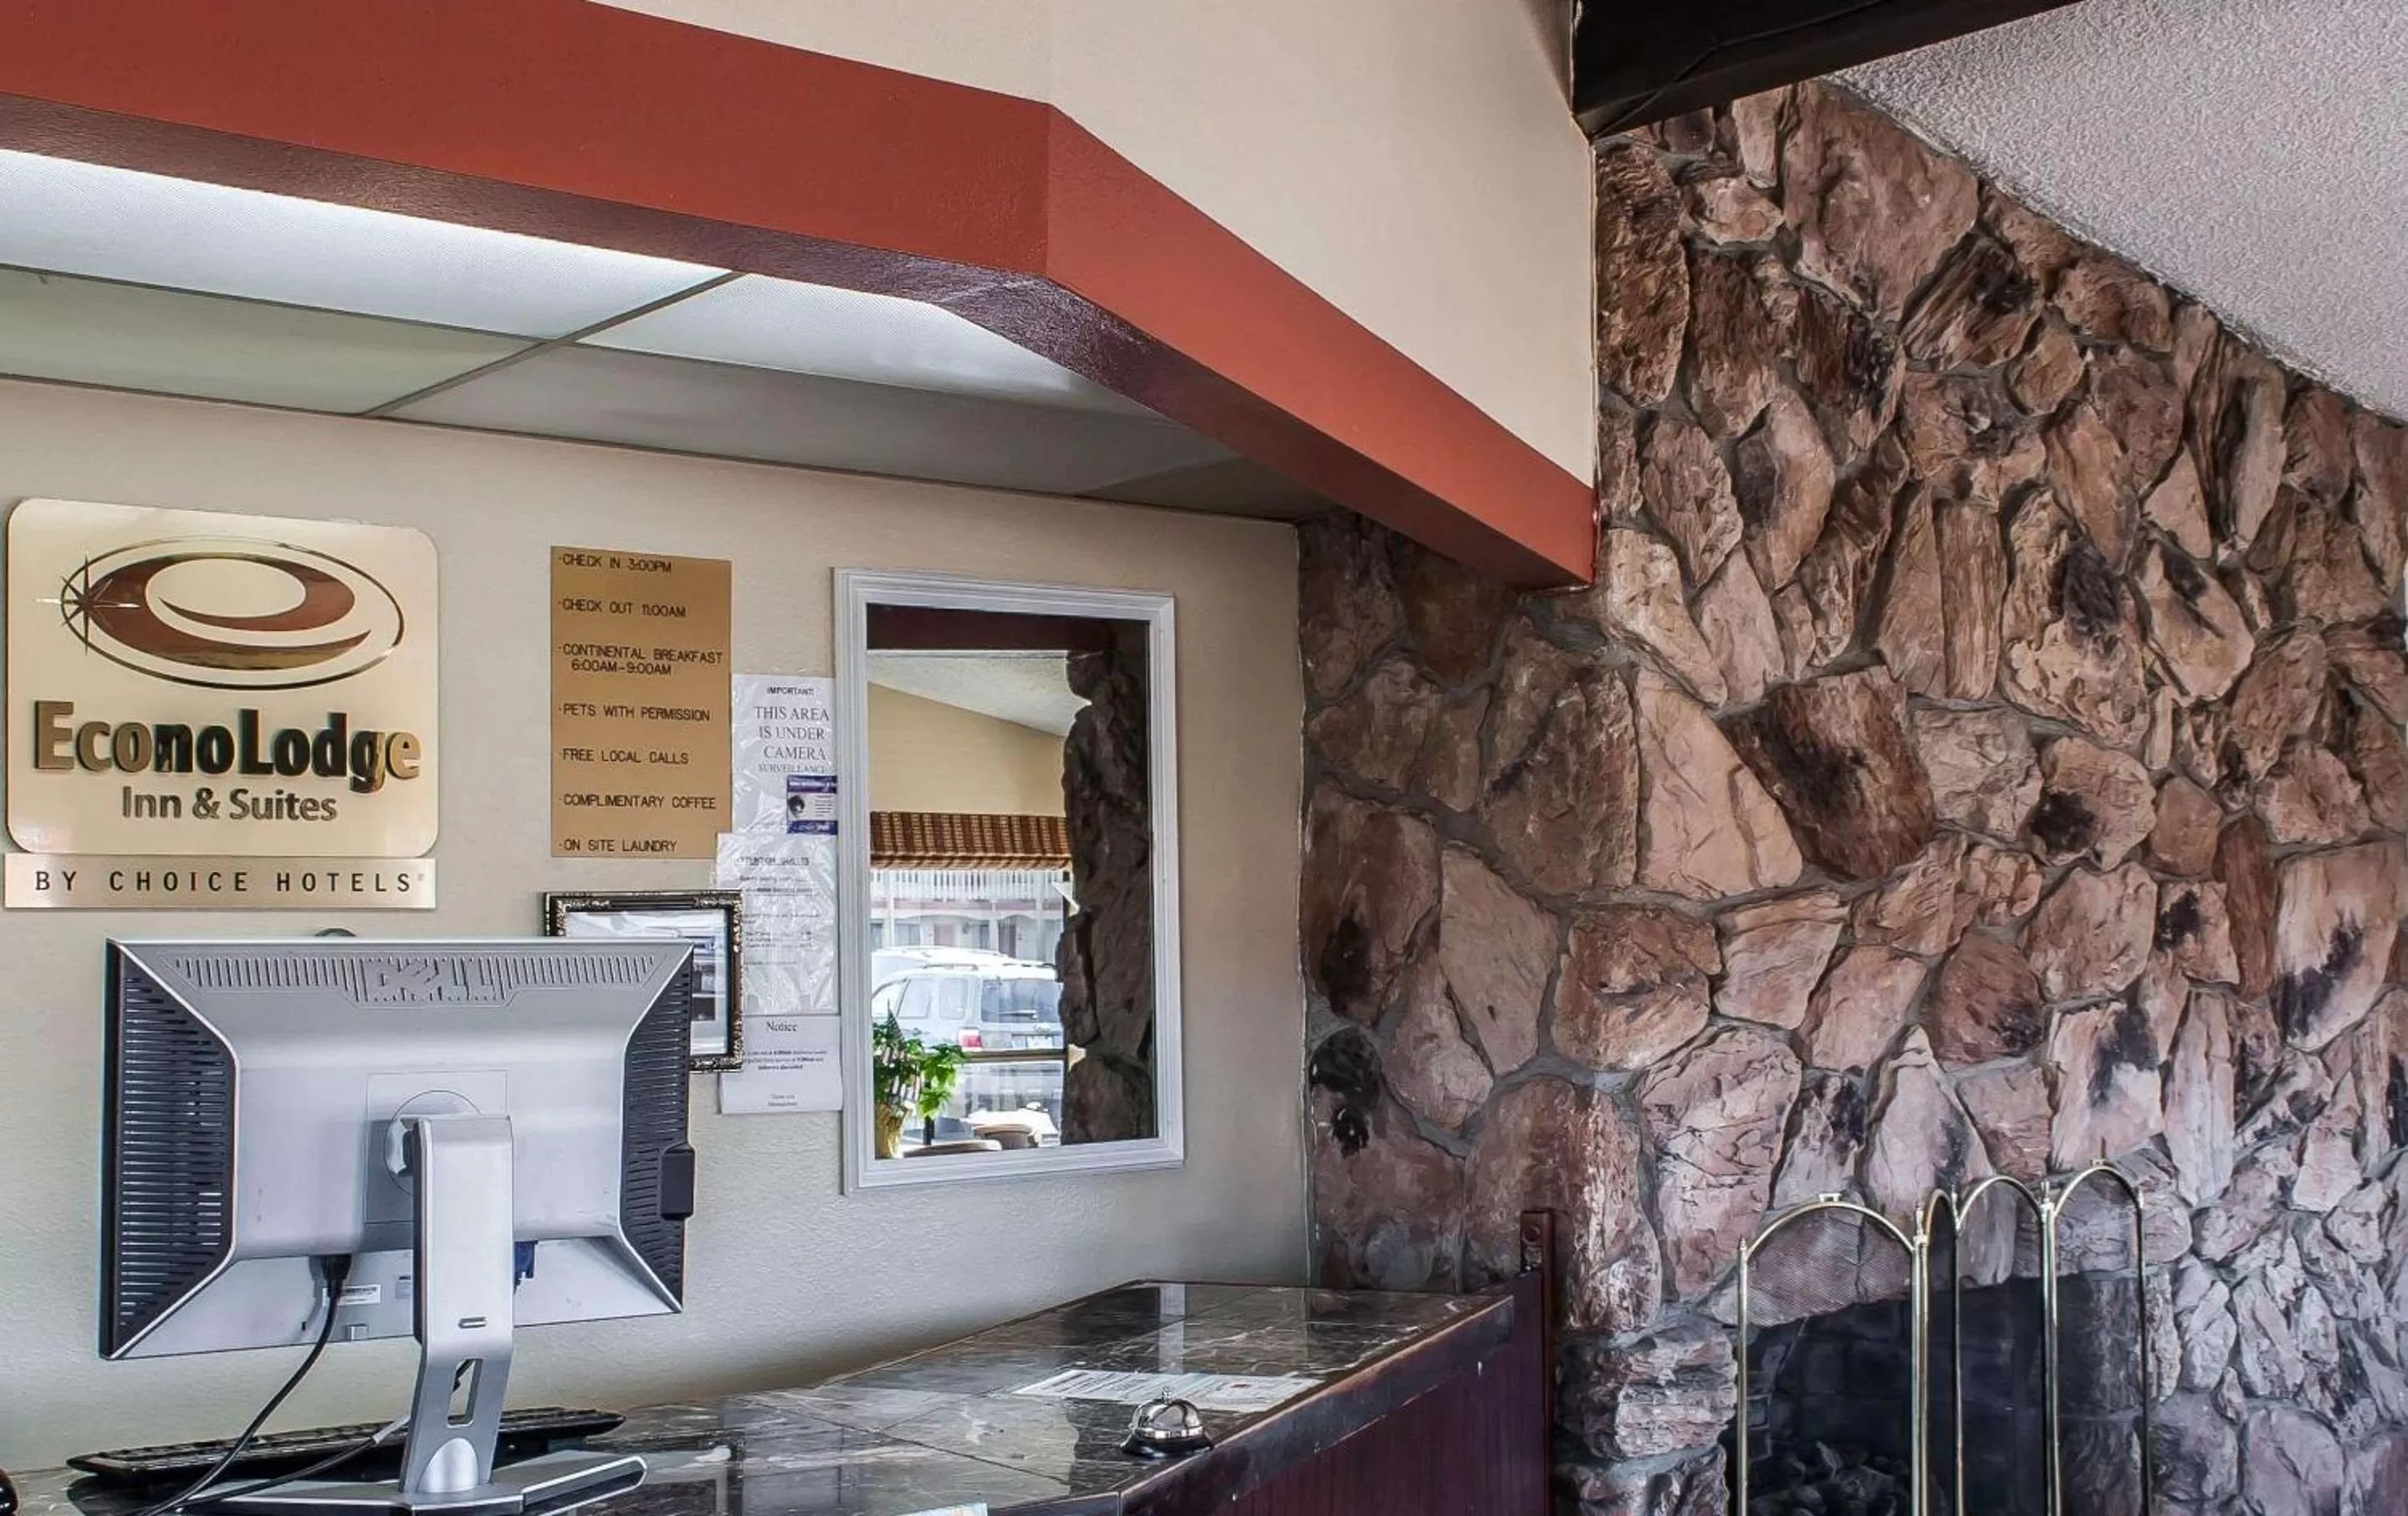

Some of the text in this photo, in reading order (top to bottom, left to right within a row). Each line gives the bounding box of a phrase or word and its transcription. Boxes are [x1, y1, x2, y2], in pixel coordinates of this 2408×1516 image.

[563, 554, 602, 567] CHECK
[610, 557, 621, 569] IN
[563, 598, 602, 612] CHECK
[610, 602, 633, 615] OUT
[563, 643, 723, 664] CONTINENTAL BREAKFAST
[563, 704, 710, 721] PETS WITH PERMISSION
[754, 706, 830, 721] THIS AREA
[759, 725, 825, 740] IS UNDER
[563, 748, 689, 765] FREE LOCAL CALLS
[764, 745, 826, 760] CAMERA
[122, 786, 338, 822] Inn & Suites
[563, 794, 717, 809] COMPLIMENTARY COFFEE
[563, 839, 677, 853] ON SITE LAUNDRY
[35, 871, 411, 893] BY CHOICE HOTELS
[766, 1021, 797, 1032] Notice
